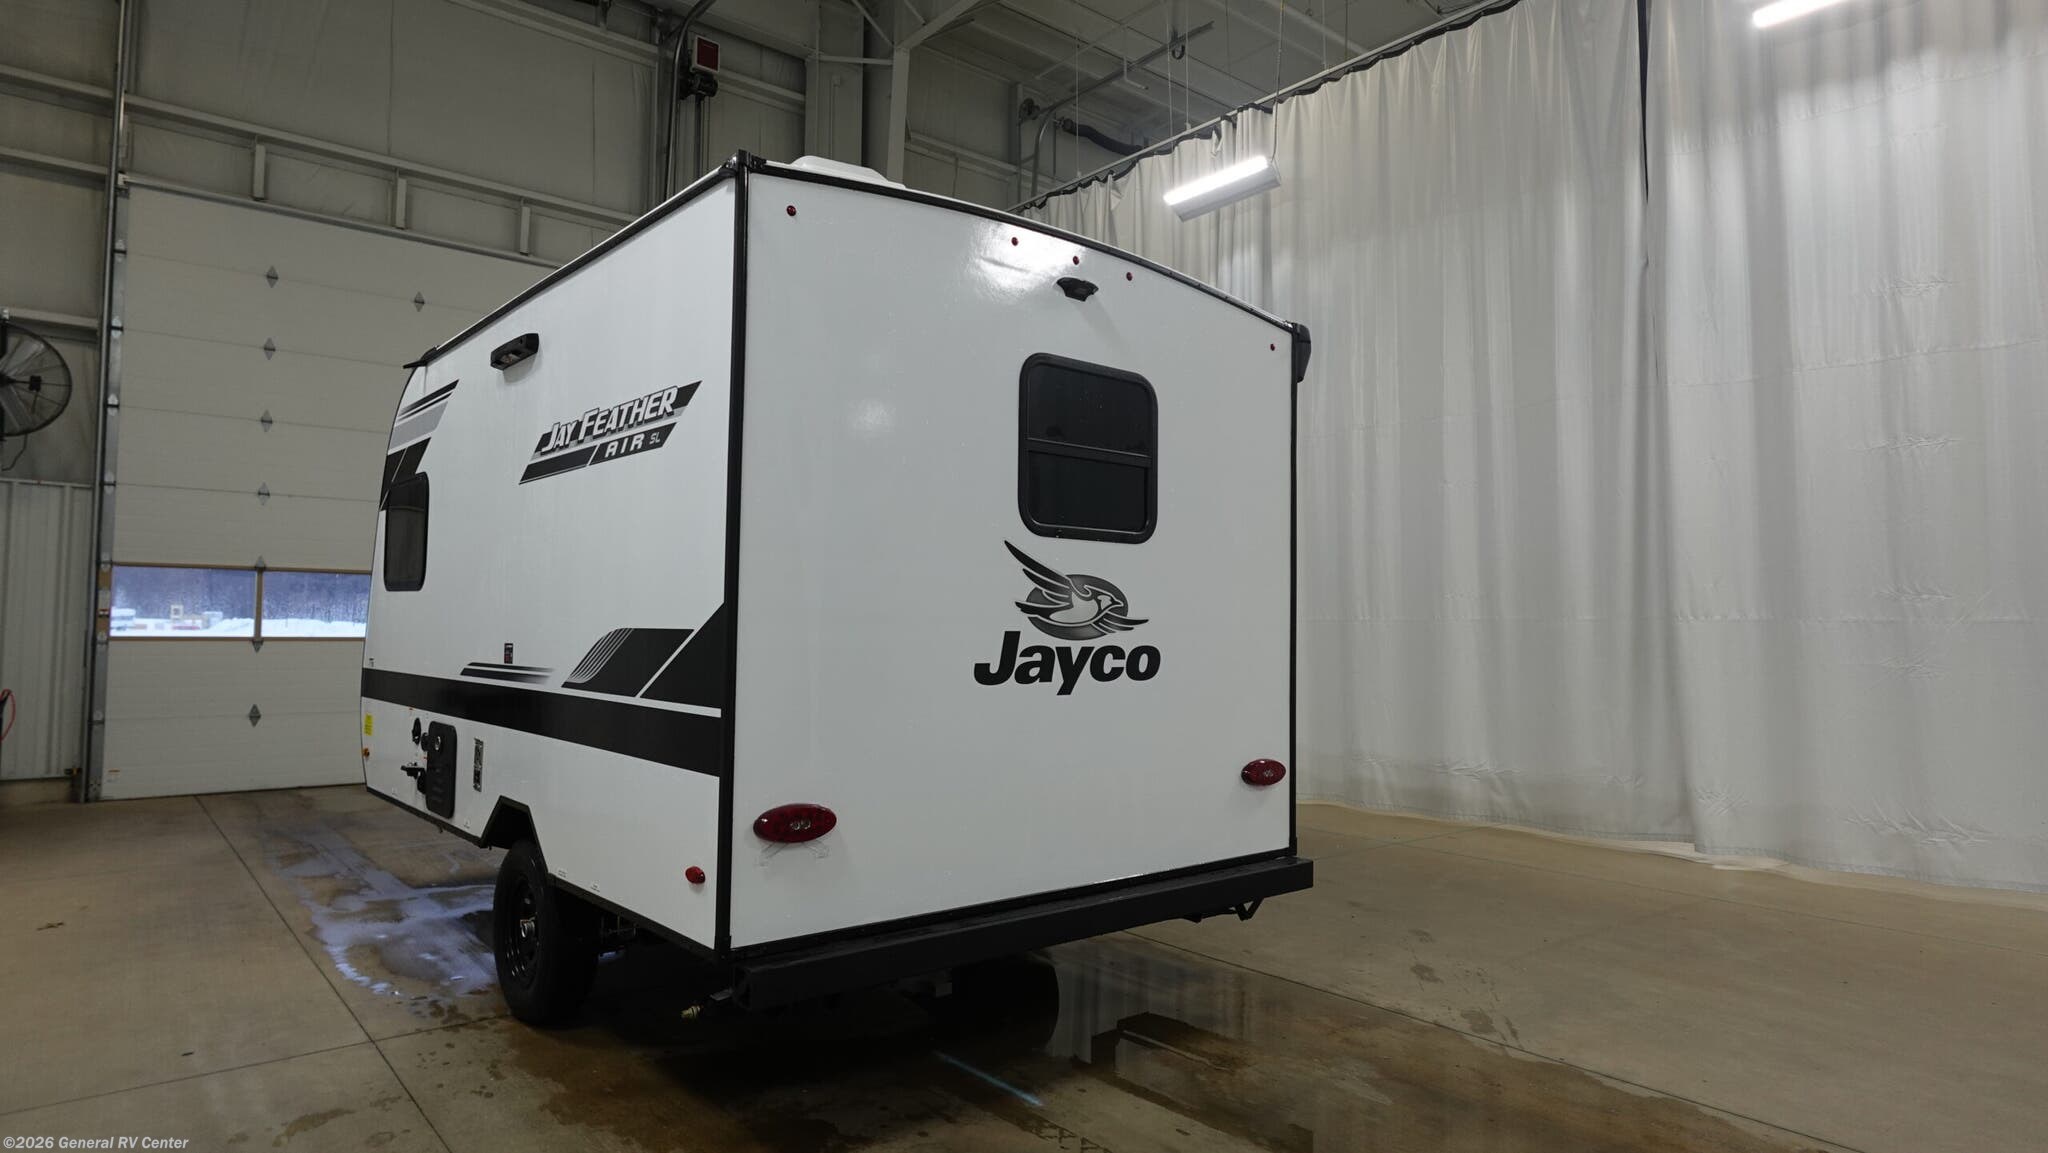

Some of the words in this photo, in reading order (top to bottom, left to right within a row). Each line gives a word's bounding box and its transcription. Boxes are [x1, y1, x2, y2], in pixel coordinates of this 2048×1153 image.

[541, 422, 577, 453] JAY
[578, 386, 679, 441] FEATHER
[604, 433, 645, 459] AIR
[650, 432, 661, 445] SL
[973, 630, 1161, 696] Jayco
